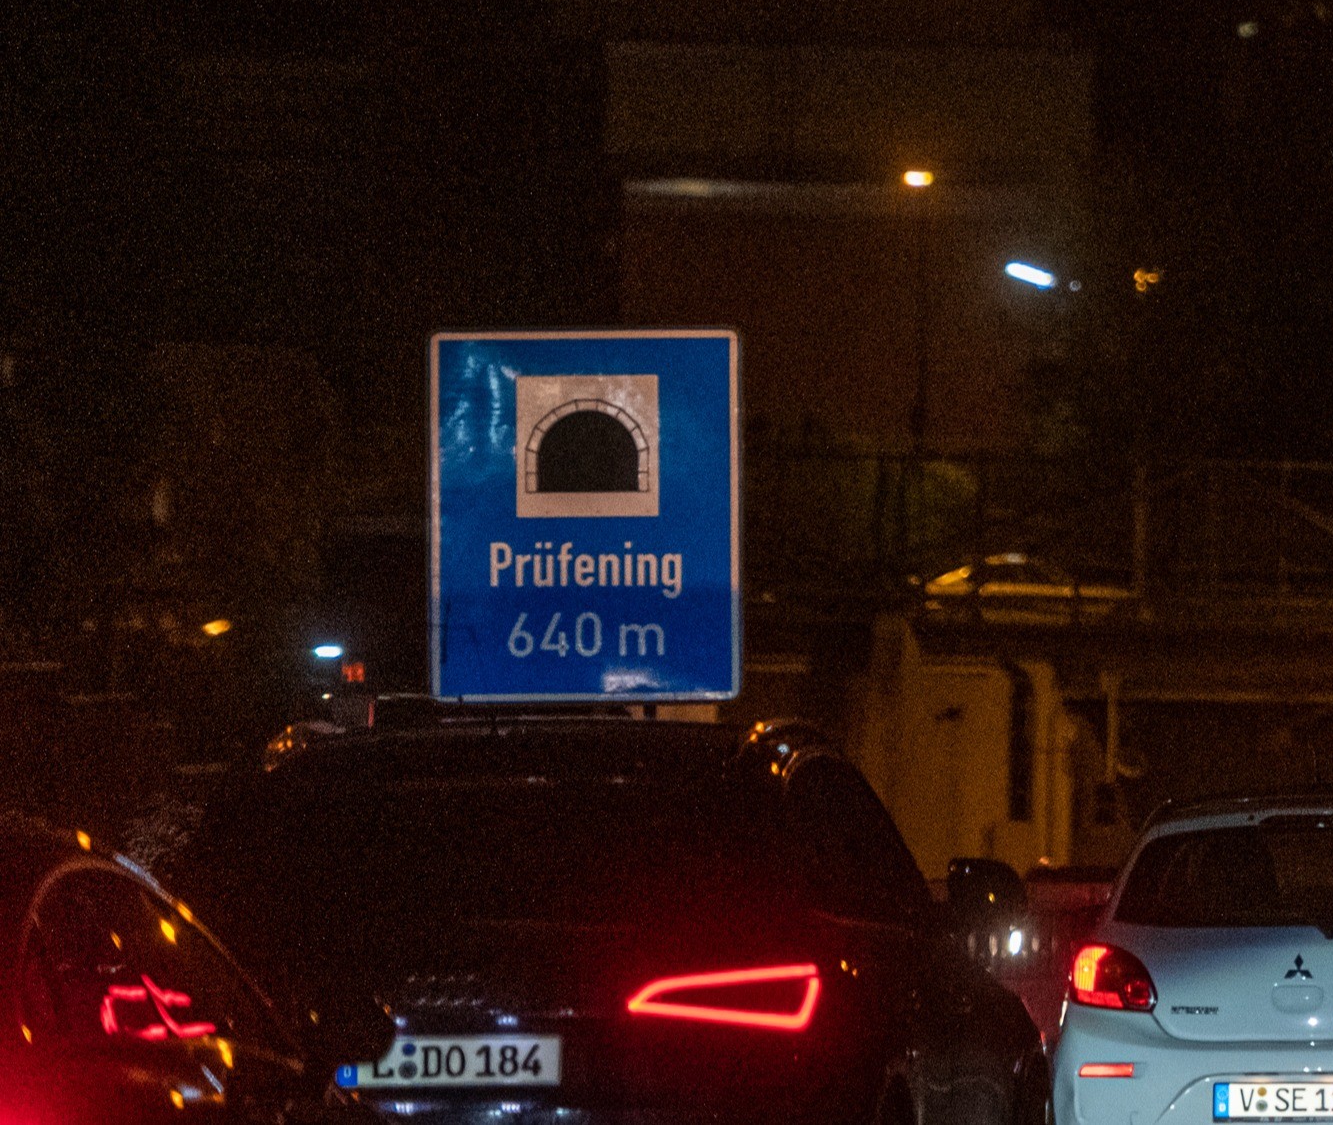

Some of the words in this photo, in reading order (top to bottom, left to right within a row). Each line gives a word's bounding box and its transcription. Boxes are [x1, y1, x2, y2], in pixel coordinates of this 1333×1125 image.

[489, 540, 683, 599] Prüfening
[507, 611, 601, 658] 640
[618, 622, 665, 657] m
[475, 1043, 542, 1077] 184
[1240, 1088, 1254, 1112] V
[1275, 1088, 1308, 1112] SE
